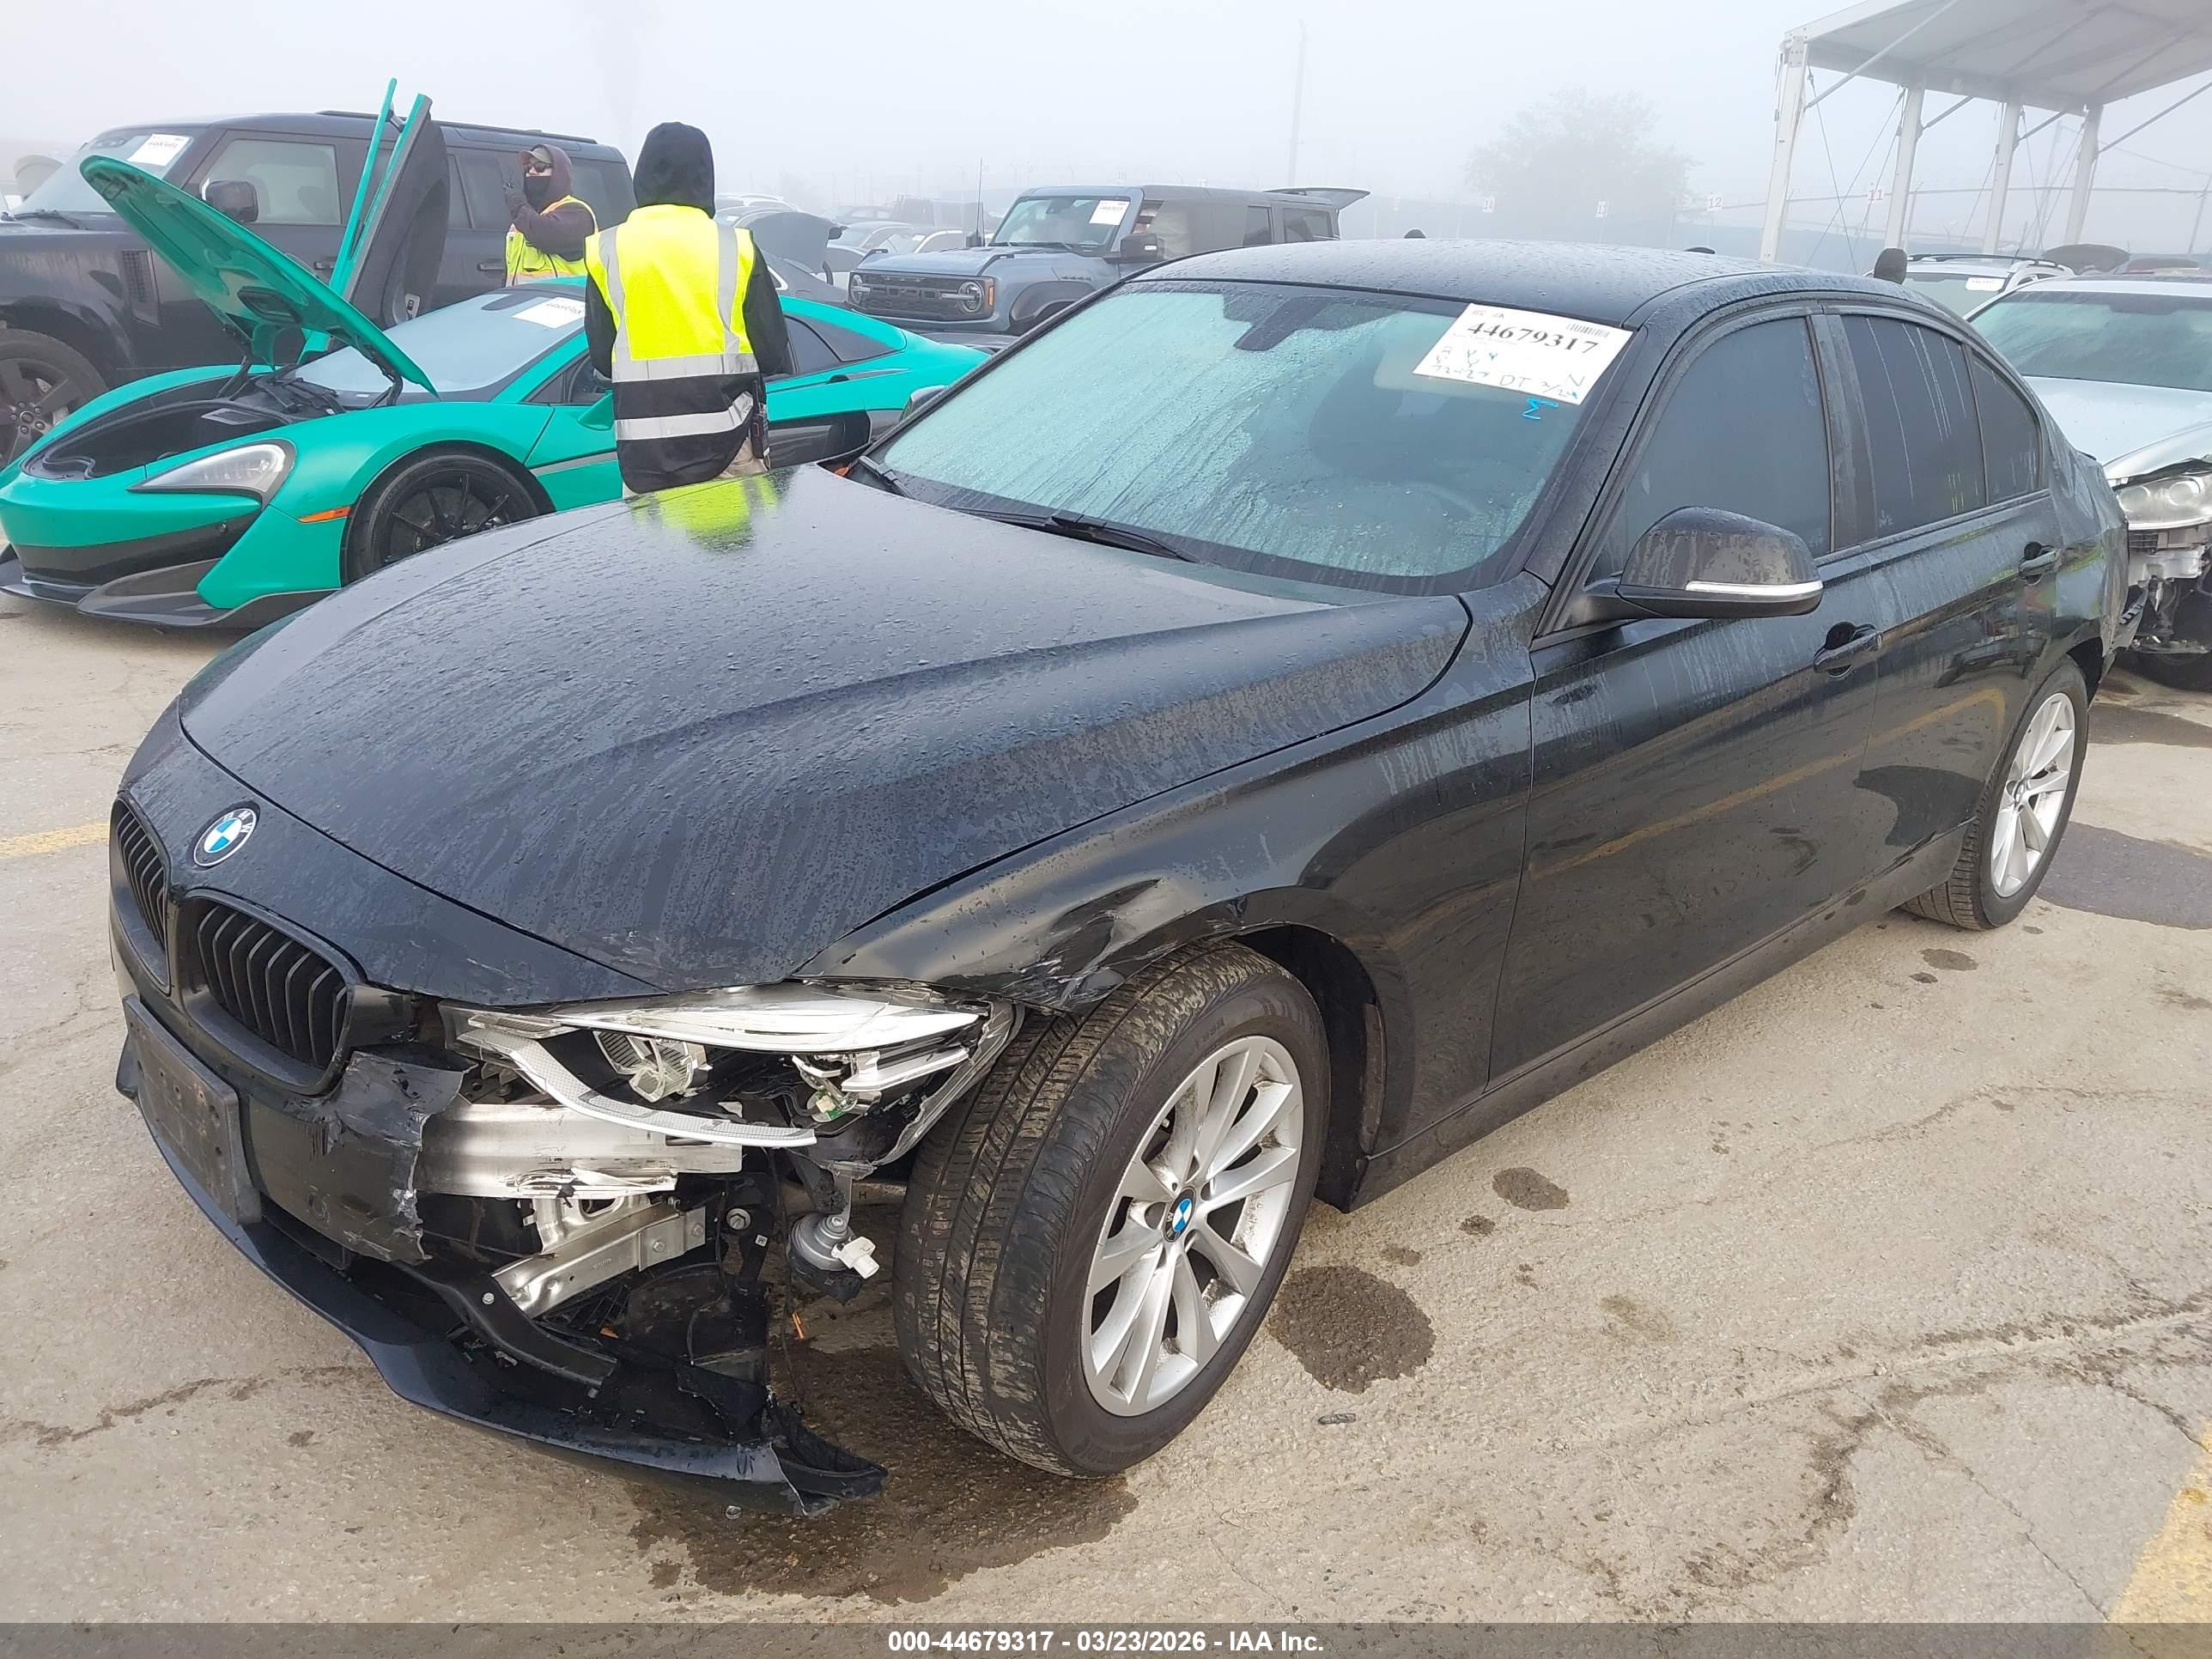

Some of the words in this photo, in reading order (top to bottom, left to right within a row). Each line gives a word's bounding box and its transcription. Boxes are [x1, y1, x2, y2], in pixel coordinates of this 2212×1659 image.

[1869, 189, 1883, 201] 11
[1709, 197, 1722, 209] 12
[1468, 322, 1600, 354] 44679317
